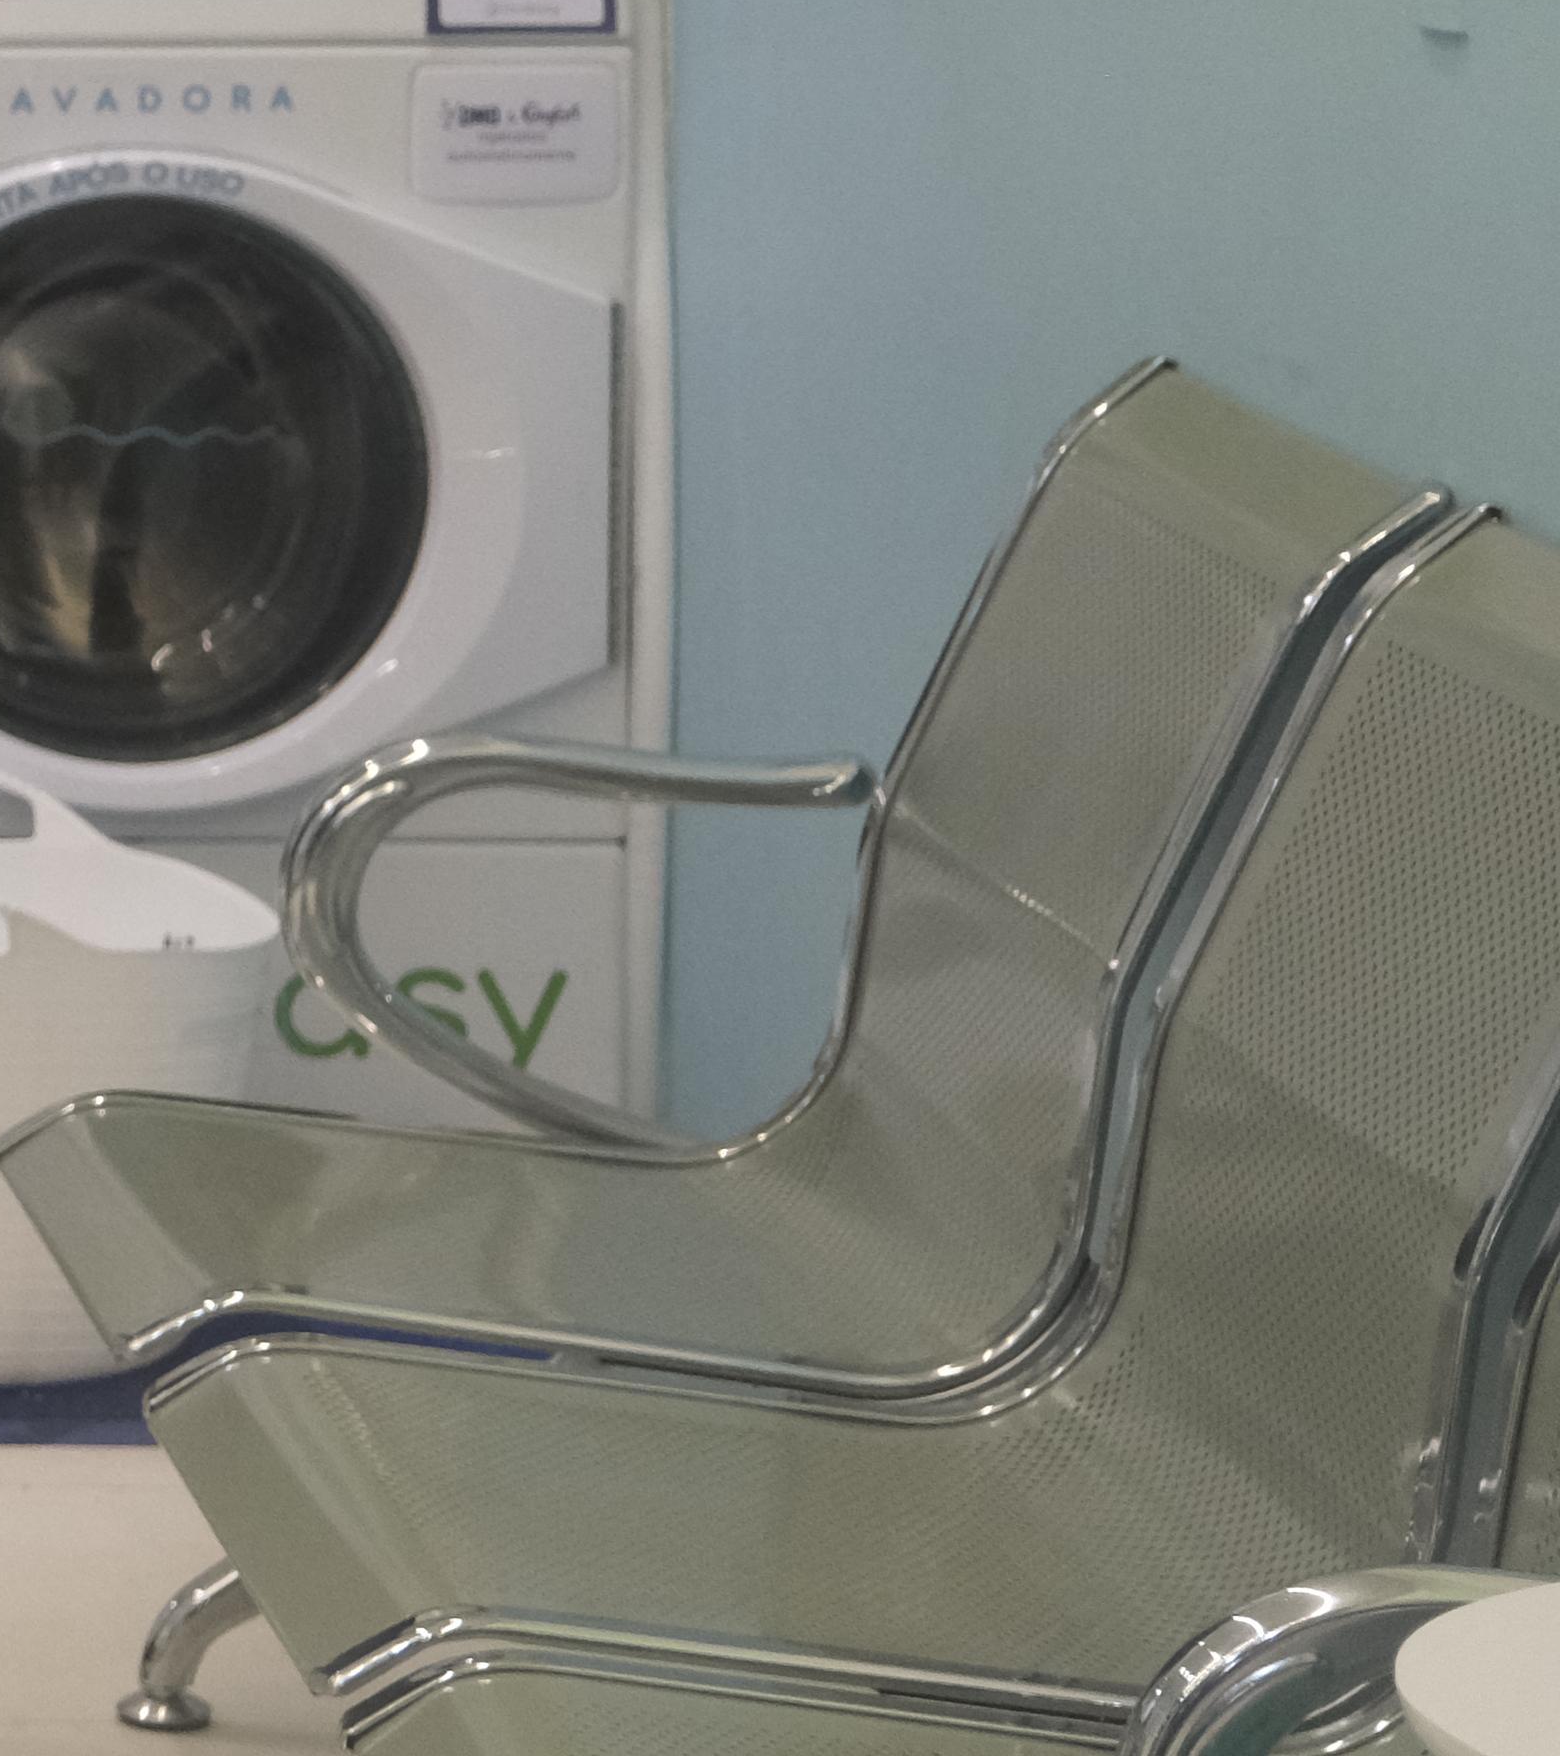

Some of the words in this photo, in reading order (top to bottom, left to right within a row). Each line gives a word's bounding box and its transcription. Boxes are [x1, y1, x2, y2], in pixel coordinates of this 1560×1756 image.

[49, 159, 130, 198] APÓS
[142, 162, 170, 188] O
[176, 164, 246, 198] USO
